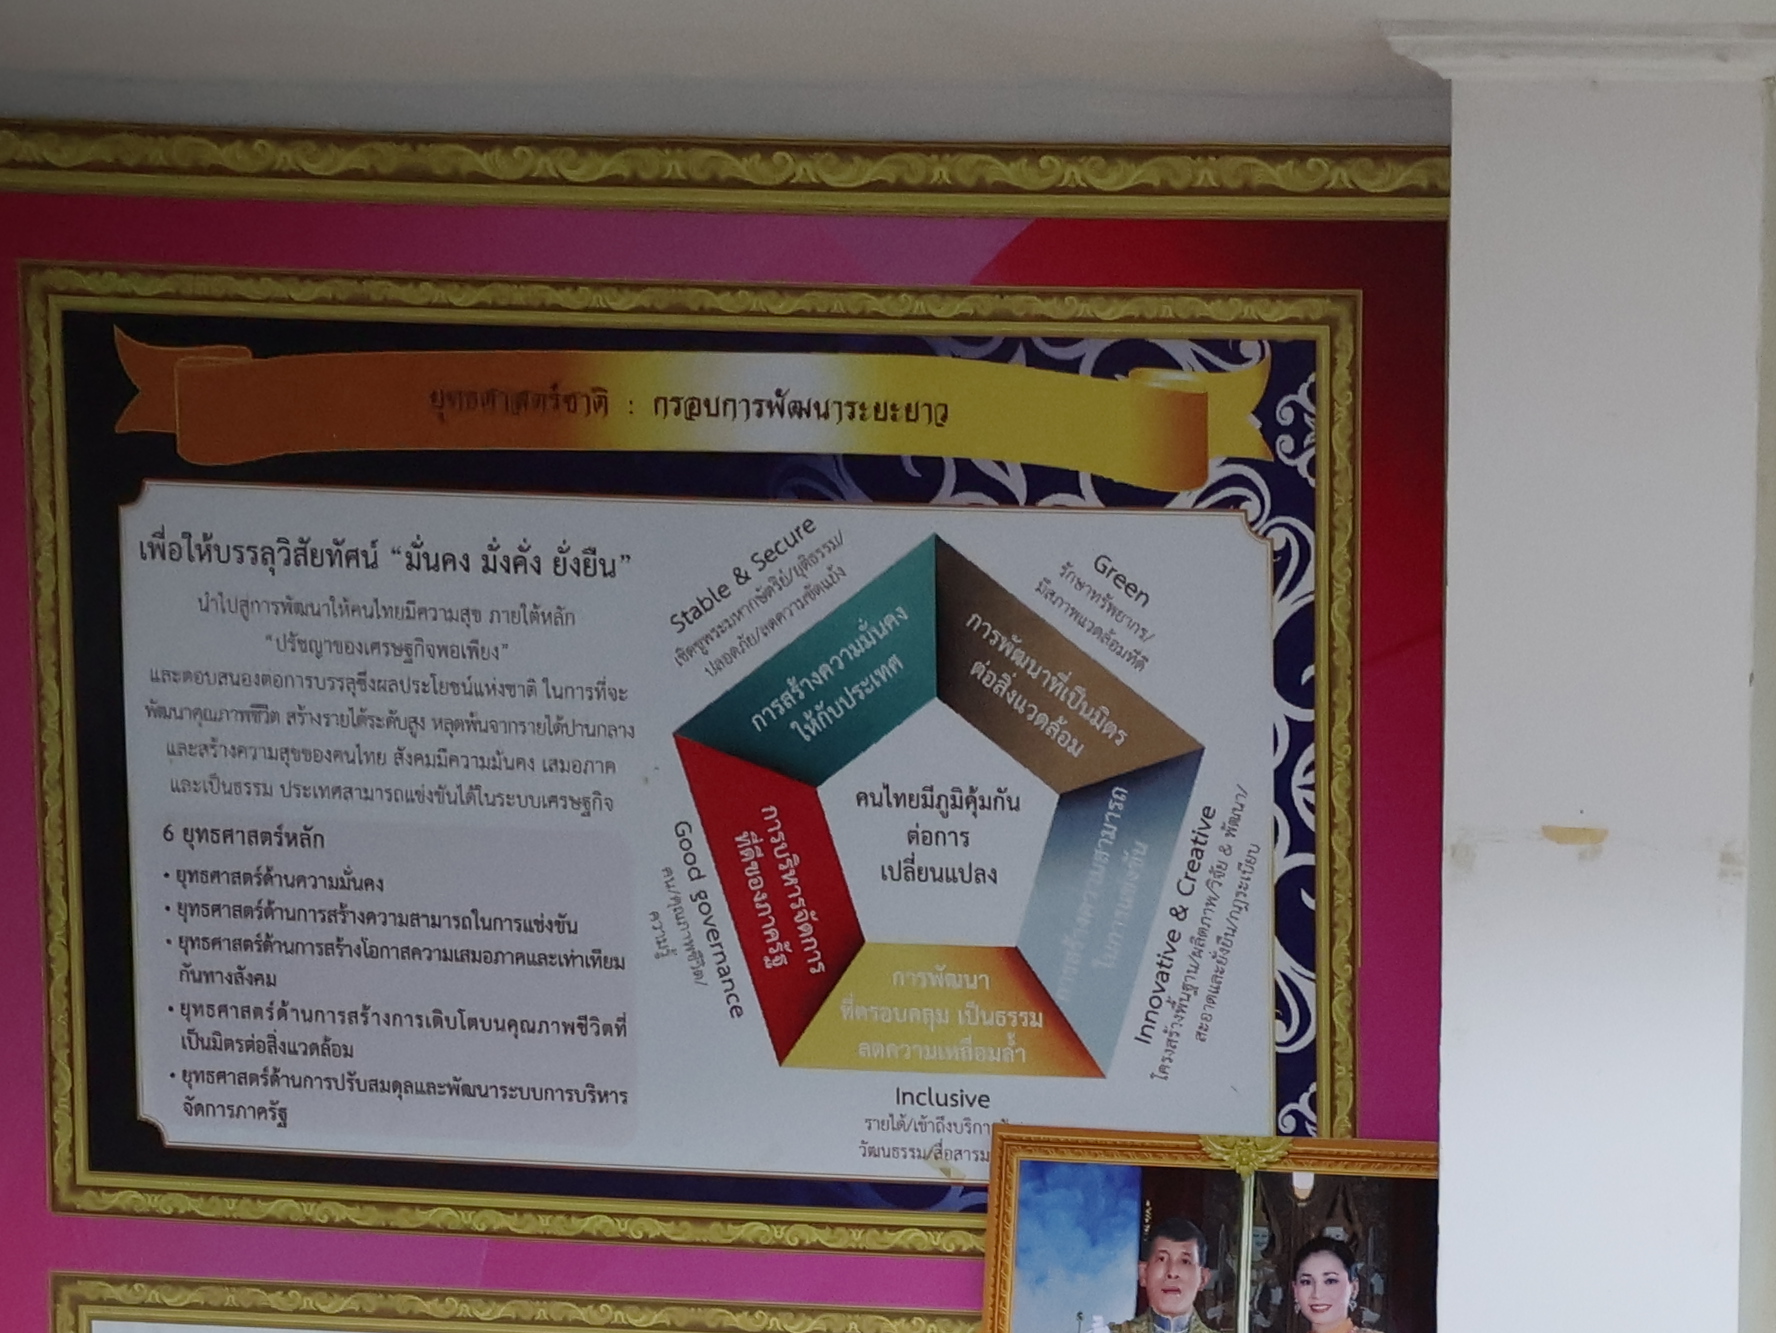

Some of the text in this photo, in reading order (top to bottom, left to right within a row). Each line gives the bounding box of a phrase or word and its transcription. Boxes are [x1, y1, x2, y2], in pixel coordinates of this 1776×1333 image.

[653, 387, 949, 428] กรอบการพัฒนาระยะยาว
[139, 525, 380, 576] เพื่อให้บรรลุวิสัยทัศน์
[481, 536, 543, 576] มั่งคั่ง
[670, 518, 817, 634] Stable & Secure
[1094, 554, 1151, 609] Green
[969, 659, 1086, 758] ต่อสิ่งแวดล้อม
[855, 783, 1021, 821] คนไทยมีภูมิคุ้มกัน
[162, 823, 326, 850] 6 ยุทธศาสตร์หลัก
[906, 825, 970, 849] ต่อการ
[880, 853, 998, 885] เปลี่ยนแปลง
[760, 804, 826, 975] การบริหารจัดการ
[673, 820, 745, 1020] Good governance
[1133, 805, 1217, 1045] Innovative & Creative
[892, 964, 990, 992] การพัฒนา
[957, 1001, 1043, 1030] เป็นธรรม
[183, 1095, 288, 1128] จัดการภาครัฐ
[895, 1086, 991, 1109] Inclusive
[864, 1113, 991, 1136] รายได้/เข้าถึงบริกา
[858, 1138, 990, 1163] วัฒนธรรม/สื่อสารม
